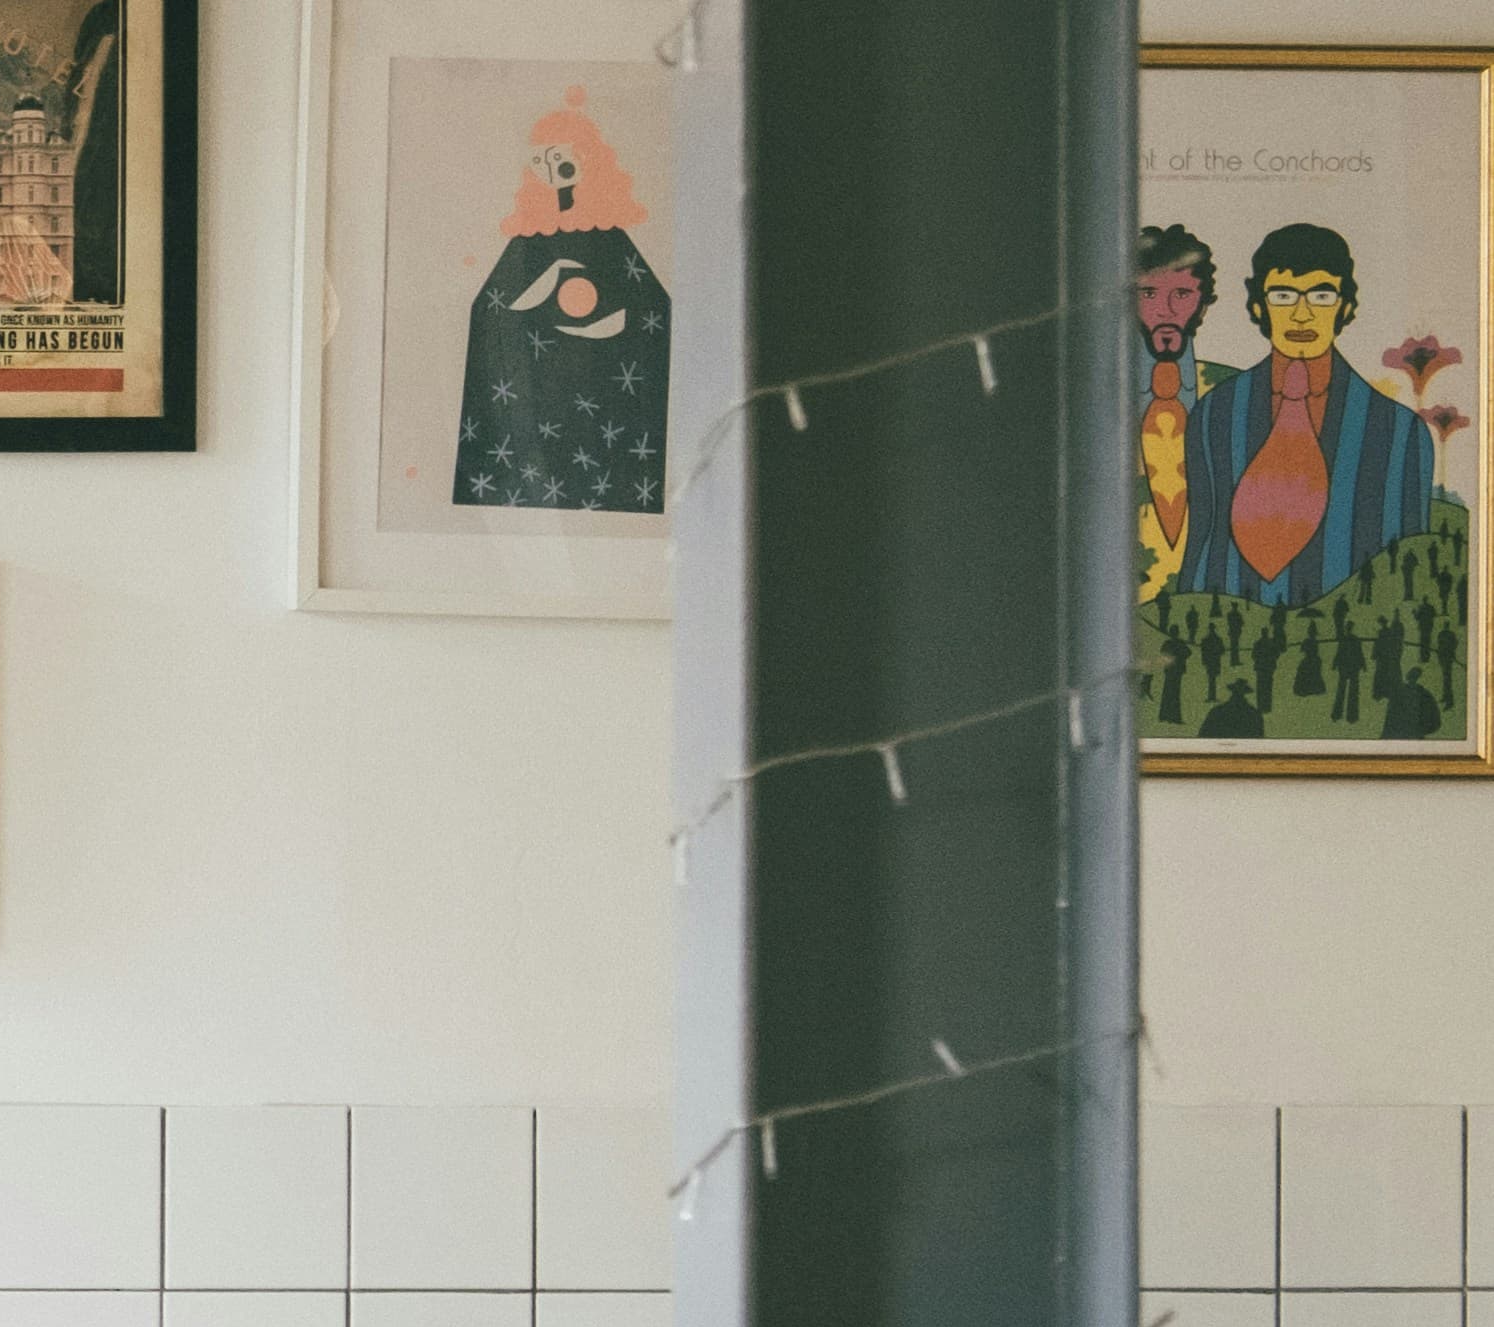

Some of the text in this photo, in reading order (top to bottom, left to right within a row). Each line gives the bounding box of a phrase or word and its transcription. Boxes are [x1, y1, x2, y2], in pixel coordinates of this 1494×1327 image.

[1168, 147, 1192, 171] of
[1204, 147, 1242, 172] the
[1253, 147, 1374, 173] Conchords
[63, 314, 75, 326] AS
[26, 331, 60, 350] HAS
[69, 331, 124, 350] BEGUN
